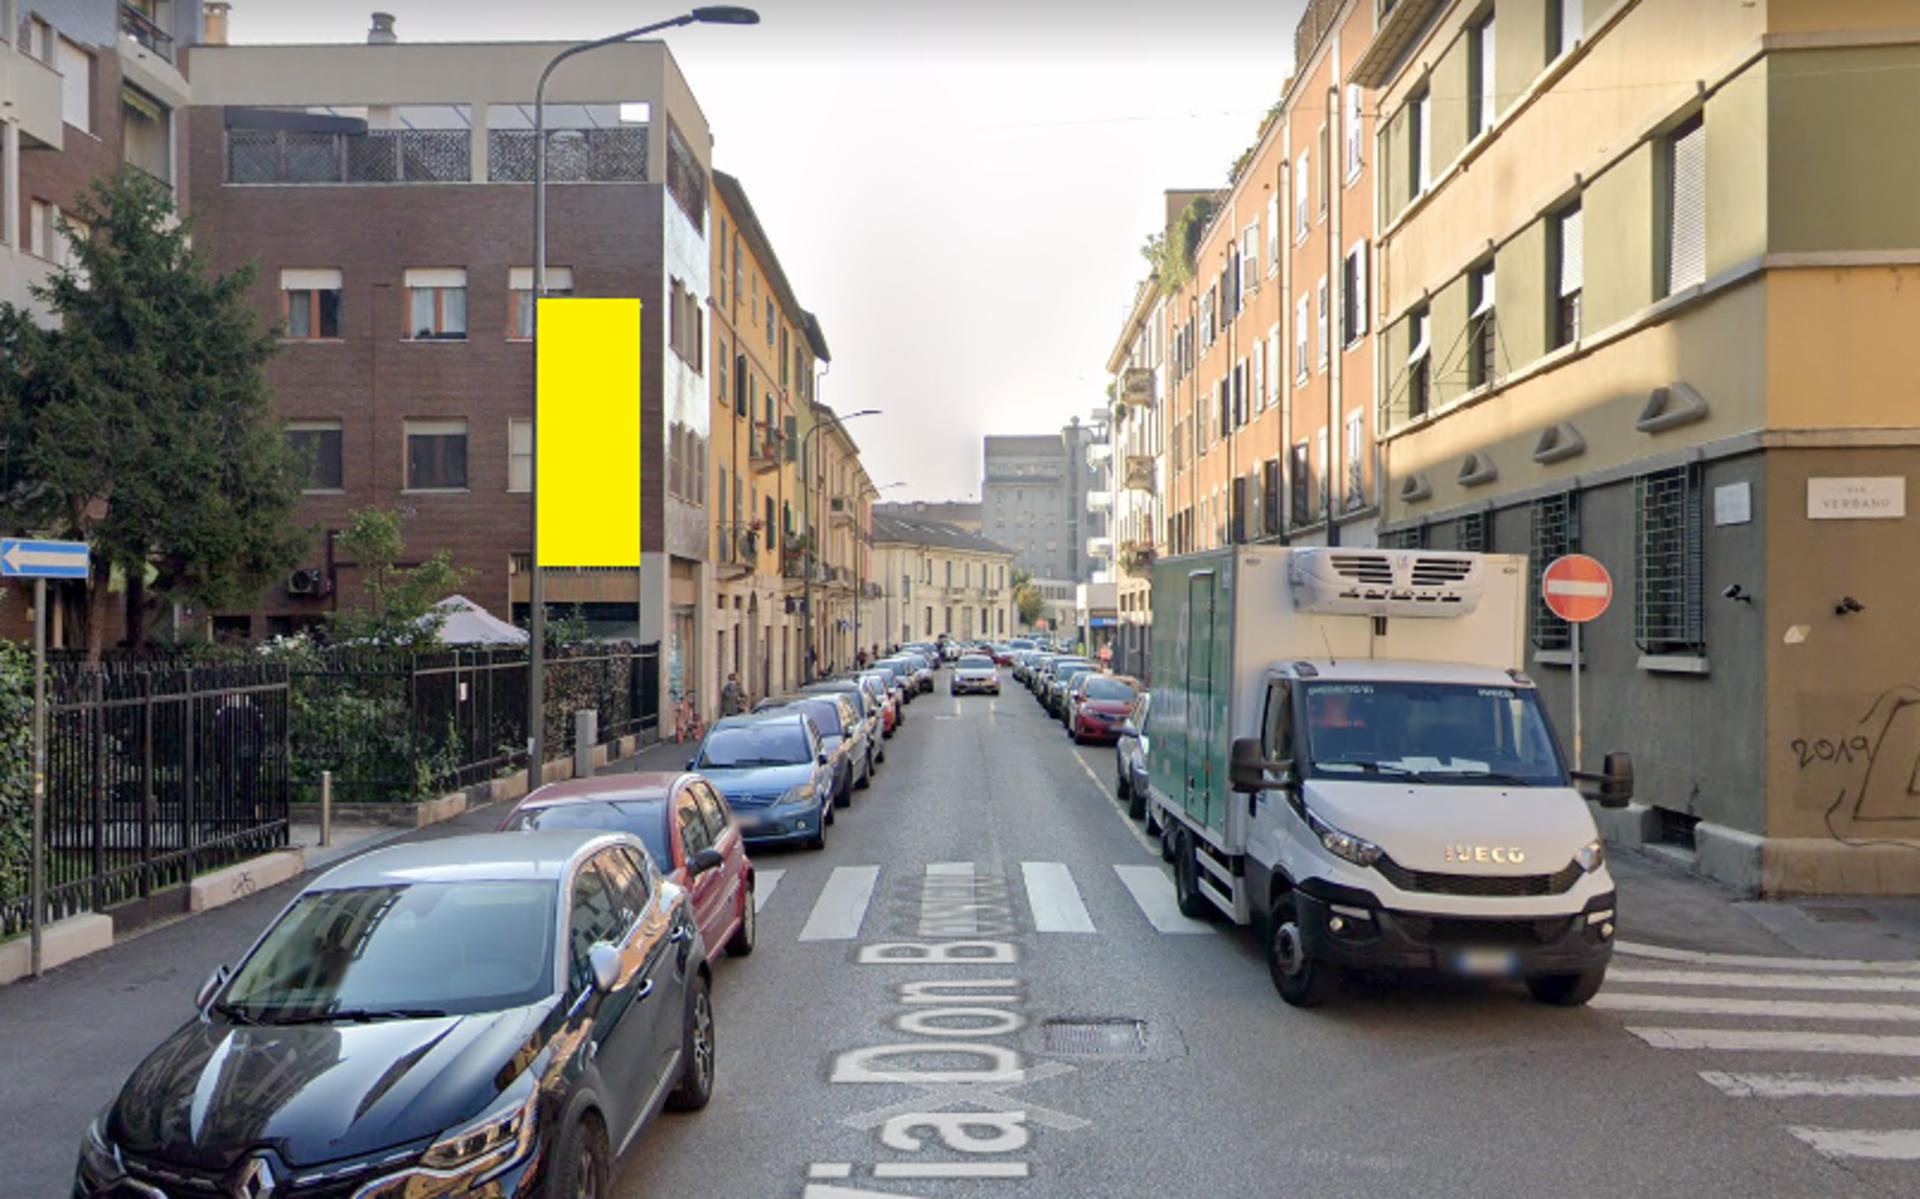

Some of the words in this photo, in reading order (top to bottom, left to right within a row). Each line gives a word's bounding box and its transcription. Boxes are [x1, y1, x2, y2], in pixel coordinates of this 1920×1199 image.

[1822, 499, 1891, 510] VERBANO
[1791, 735, 1873, 768] 2019
[1444, 843, 1525, 864] IVECO
